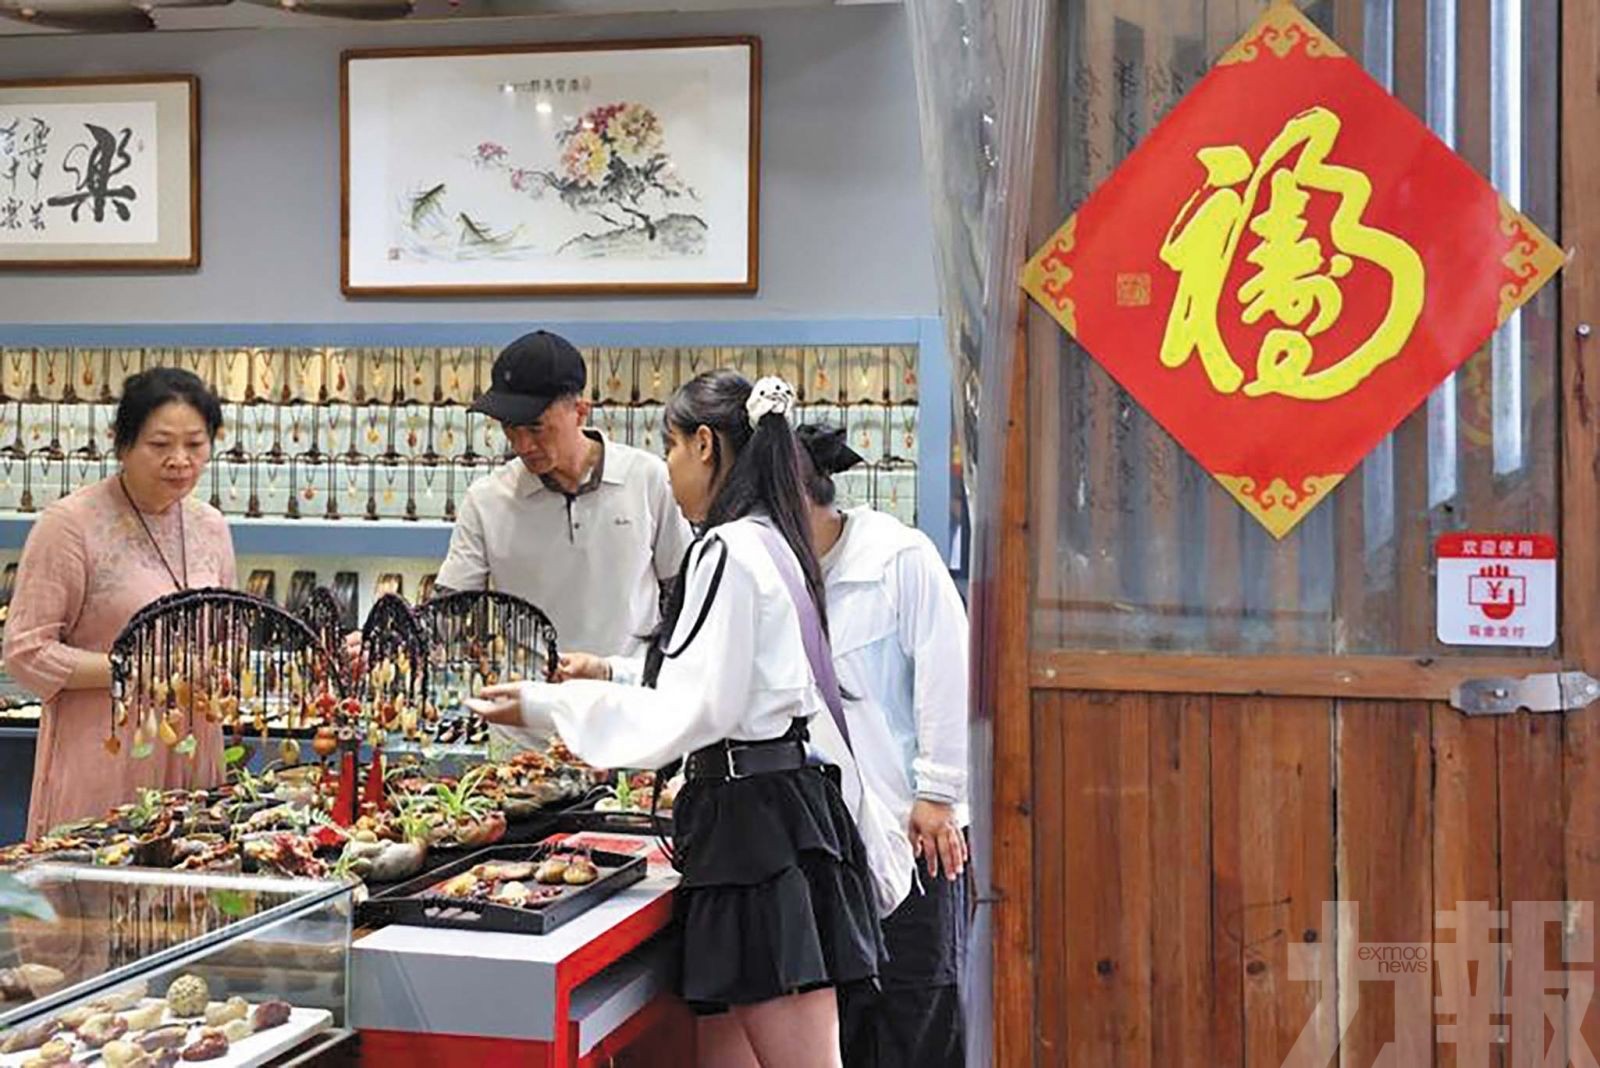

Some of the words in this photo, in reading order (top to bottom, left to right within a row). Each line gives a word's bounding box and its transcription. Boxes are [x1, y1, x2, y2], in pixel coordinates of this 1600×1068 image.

[1159, 107, 1425, 400] 福
[1462, 540, 1533, 556] 欢迎使用
